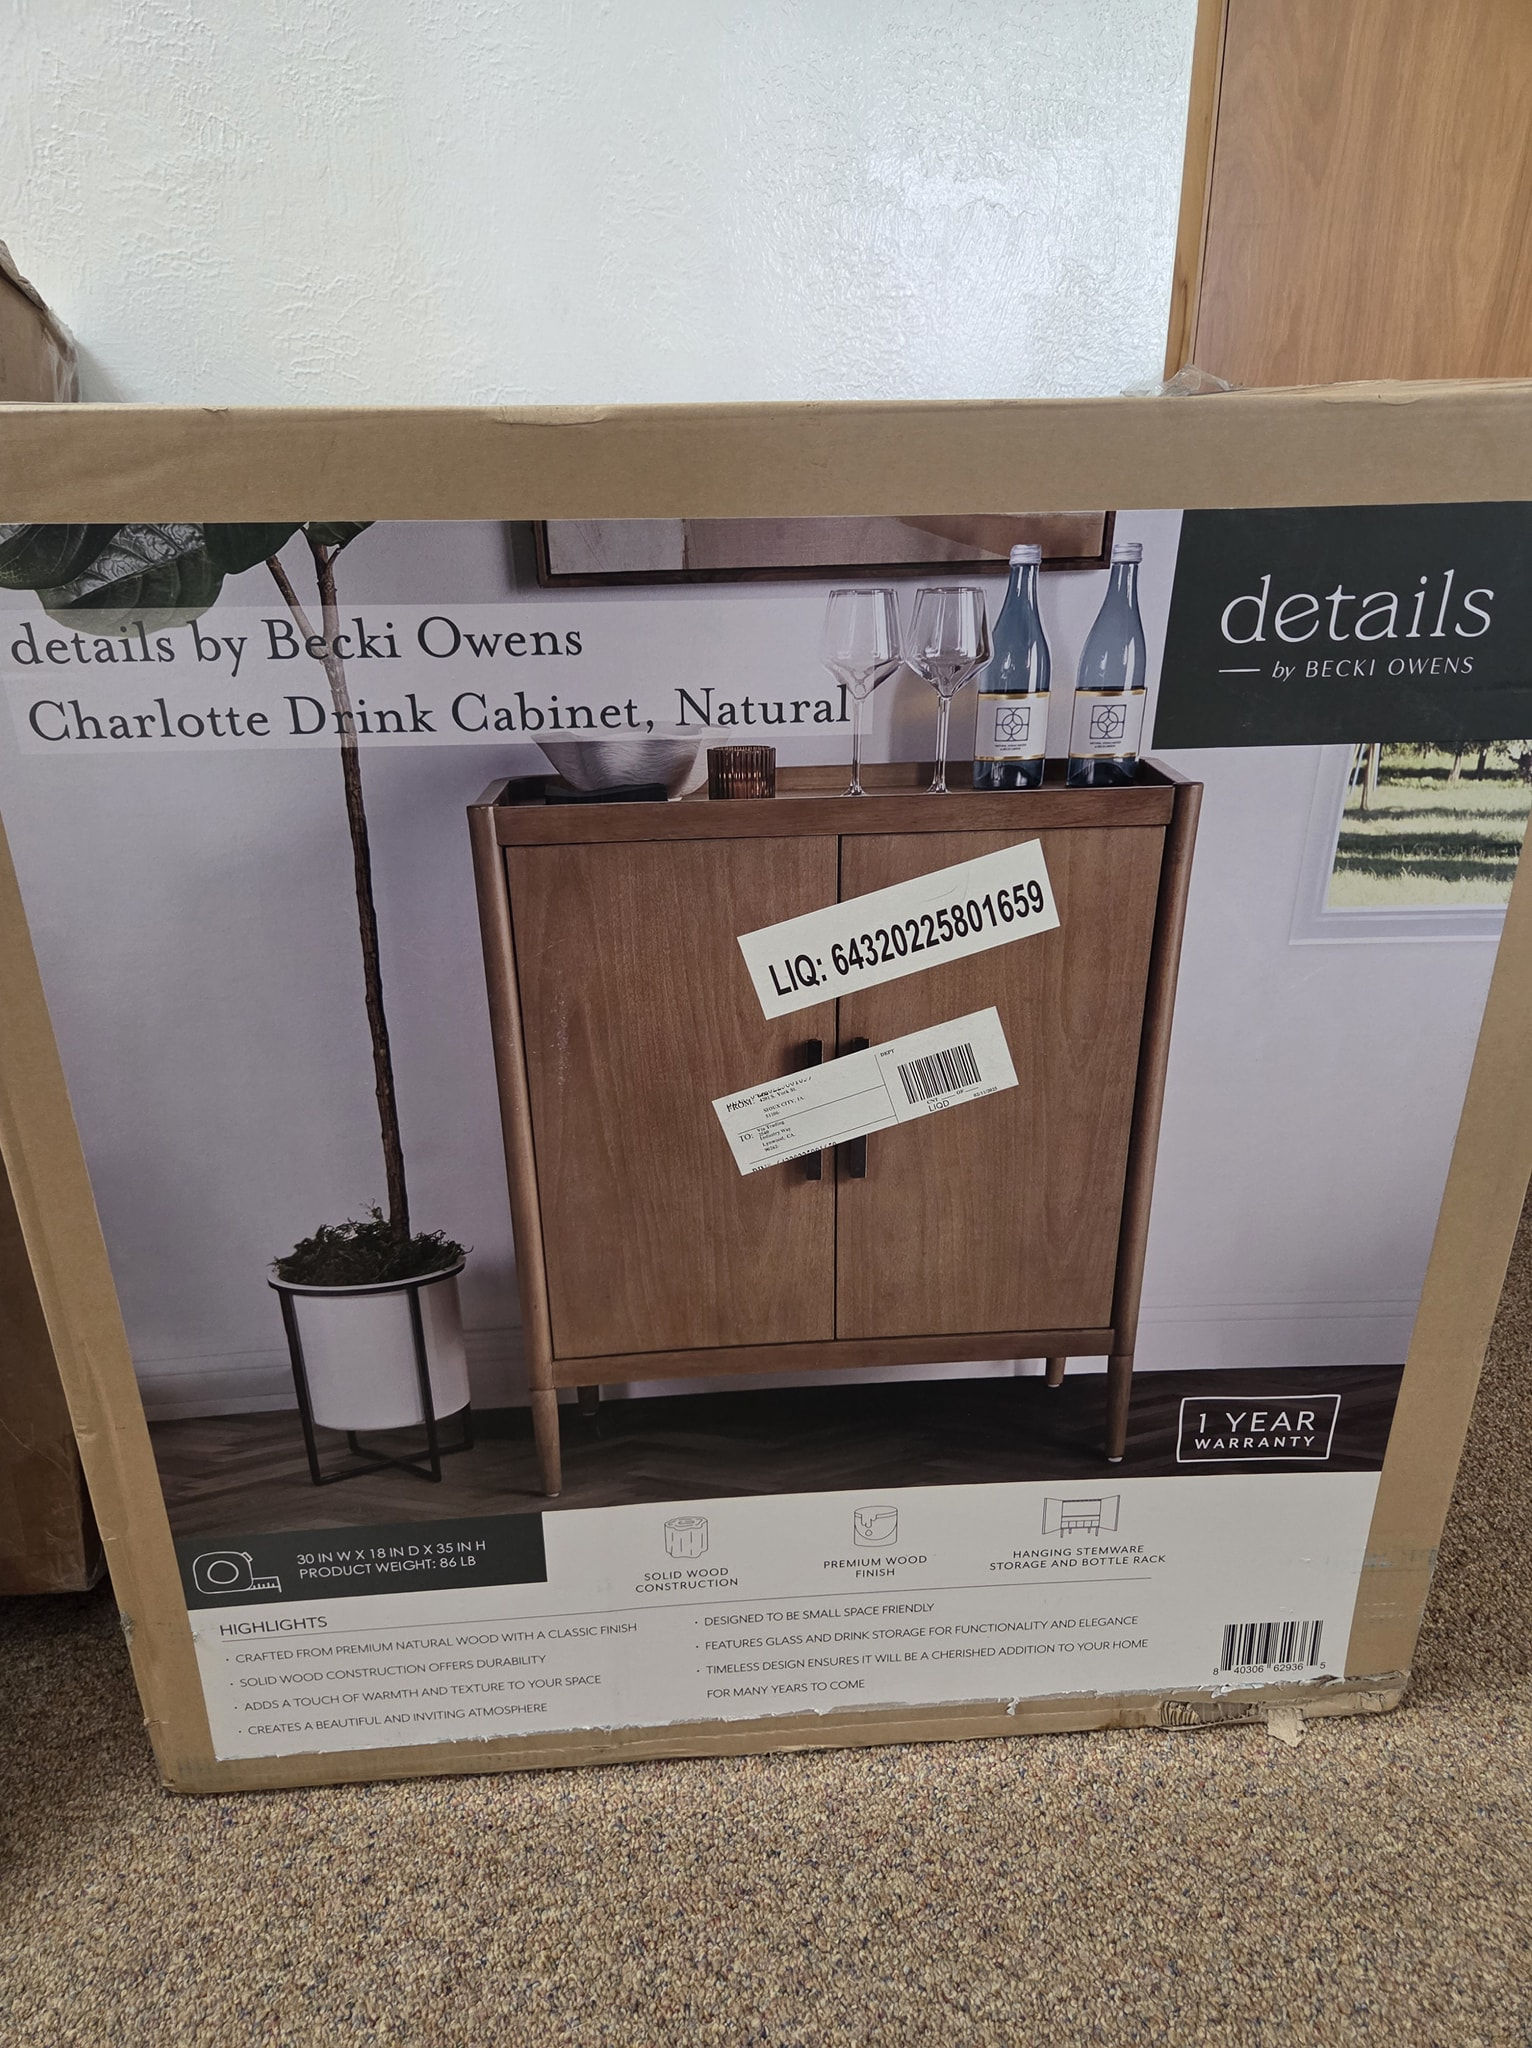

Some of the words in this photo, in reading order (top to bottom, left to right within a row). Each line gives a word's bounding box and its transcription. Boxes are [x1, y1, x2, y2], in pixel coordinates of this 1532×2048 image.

[1221, 569, 1494, 644] details
[12, 621, 175, 665] details
[190, 619, 248, 677] by
[265, 616, 402, 662] Becki
[418, 616, 582, 658] Owens
[1272, 660, 1296, 682] by
[1306, 659, 1375, 678] BECKI
[1388, 656, 1474, 675] OWENS
[29, 698, 270, 741] Charlotte
[282, 693, 437, 739] Drink
[452, 691, 654, 733] Cabinet,
[675, 682, 852, 727] Natural
[768, 954, 827, 996] LIQ:
[832, 880, 1044, 975] 64320225801659
[1200, 1413, 1206, 1433] 1
[1226, 1411, 1314, 1432] YEAR
[1195, 1436, 1314, 1449] WARRANTY
[296, 1554, 314, 1564] 30
[318, 1552, 332, 1562] IN
[336, 1551, 350, 1561] W
[355, 1550, 365, 1560] X
[370, 1548, 386, 1559] 18
[390, 1546, 404, 1557] IN
[408, 1546, 419, 1556] D
[423, 1544, 432, 1554] X
[436, 1543, 453, 1554] 35
[457, 1542, 471, 1552] IN
[476, 1540, 486, 1550] H
[824, 1558, 880, 1568] PREMIUM
[886, 1554, 927, 1565] WOOD
[990, 1560, 1046, 1570] STORAGE
[1050, 1559, 1077, 1568] AND
[1082, 1556, 1128, 1566] BOTTLE
[1133, 1555, 1166, 1564] RACK
[1013, 1548, 1071, 1558] HANGING
[1076, 1545, 1144, 1556] STEMWARE
[300, 1564, 371, 1579] PRODUCT
[375, 1559, 436, 1572] WEIGHT:
[440, 1557, 456, 1568] 86
[461, 1556, 476, 1566] LB
[644, 1571, 682, 1581] SOLID
[686, 1568, 728, 1578] WOOD
[856, 1568, 894, 1578] FINISH
[636, 1578, 738, 1593] CONSTRUCTION
[220, 1616, 327, 1636] HIGHLIGHTS
[704, 1614, 764, 1626] DESIGNED
[766, 1612, 783, 1622] TO
[786, 1611, 800, 1620] BE
[802, 1608, 841, 1620] SMALL
[844, 1606, 879, 1617] SPACE
[882, 1603, 934, 1614] FRIENDLY
[236, 1650, 294, 1664] CRAFTED
[296, 1647, 333, 1658] FROM
[336, 1642, 393, 1654] PREMIUM
[396, 1638, 454, 1650] NATURAL
[456, 1634, 498, 1645] WOOD
[501, 1632, 534, 1642] WITH
[536, 1631, 546, 1639] A
[548, 1627, 598, 1639] CLASSIC
[600, 1622, 637, 1634] FINISH
[706, 1638, 763, 1650] FEATURES
[766, 1635, 803, 1646] GLASS
[805, 1634, 832, 1643] AND
[834, 1631, 870, 1641] DRINK
[872, 1628, 926, 1639] STORAGE
[929, 1626, 952, 1636] FOR
[955, 1620, 1048, 1634] FUNCTIONALITY
[1050, 1619, 1076, 1629] AND
[1079, 1616, 1138, 1627] ELEGANCE
[706, 1662, 760, 1674] TIMELESS
[762, 1659, 804, 1670] DESIGN
[808, 1656, 859, 1668] ENSURES
[862, 1655, 872, 1664] IT
[874, 1654, 902, 1662] WILL
[904, 1652, 918, 1661] BE
[920, 1652, 929, 1660] A
[932, 1648, 996, 1660] CHERISHED
[998, 1644, 1055, 1656] ADDITION
[1058, 1643, 1074, 1652] TO
[1077, 1641, 1110, 1651] YOUR
[1113, 1639, 1148, 1650] HOME
[240, 1676, 277, 1688] SOLID
[279, 1672, 323, 1684] WOOD
[326, 1664, 426, 1680] CONSTRUCTION
[429, 1660, 474, 1672] OFFERS
[477, 1655, 546, 1668] DURABILITY
[1213, 1668, 1219, 1676] 8
[1233, 1664, 1264, 1675] 40306
[1273, 1662, 1304, 1673] 62936
[244, 1700, 279, 1712] ADDS
[282, 1699, 291, 1708] A
[292, 1695, 340, 1707] TOUCH
[342, 1694, 359, 1703] OF
[362, 1689, 418, 1702] WARMTH
[422, 1687, 448, 1696] AND
[450, 1682, 505, 1694] TEXTURE
[507, 1680, 525, 1690] TO
[528, 1678, 562, 1688] YOUR
[565, 1674, 602, 1686] SPACE
[707, 1688, 730, 1698] FOR
[734, 1686, 768, 1696] MANY
[771, 1683, 808, 1693] YEARS
[810, 1682, 827, 1691] TO
[830, 1679, 865, 1690] COME
[248, 1722, 302, 1735] CREATES
[304, 1722, 314, 1730] A
[316, 1716, 382, 1730] BEAUTIFUL
[384, 1714, 410, 1724] AND
[413, 1709, 465, 1721] INVITING
[468, 1703, 548, 1717] ATMOSPHERE
